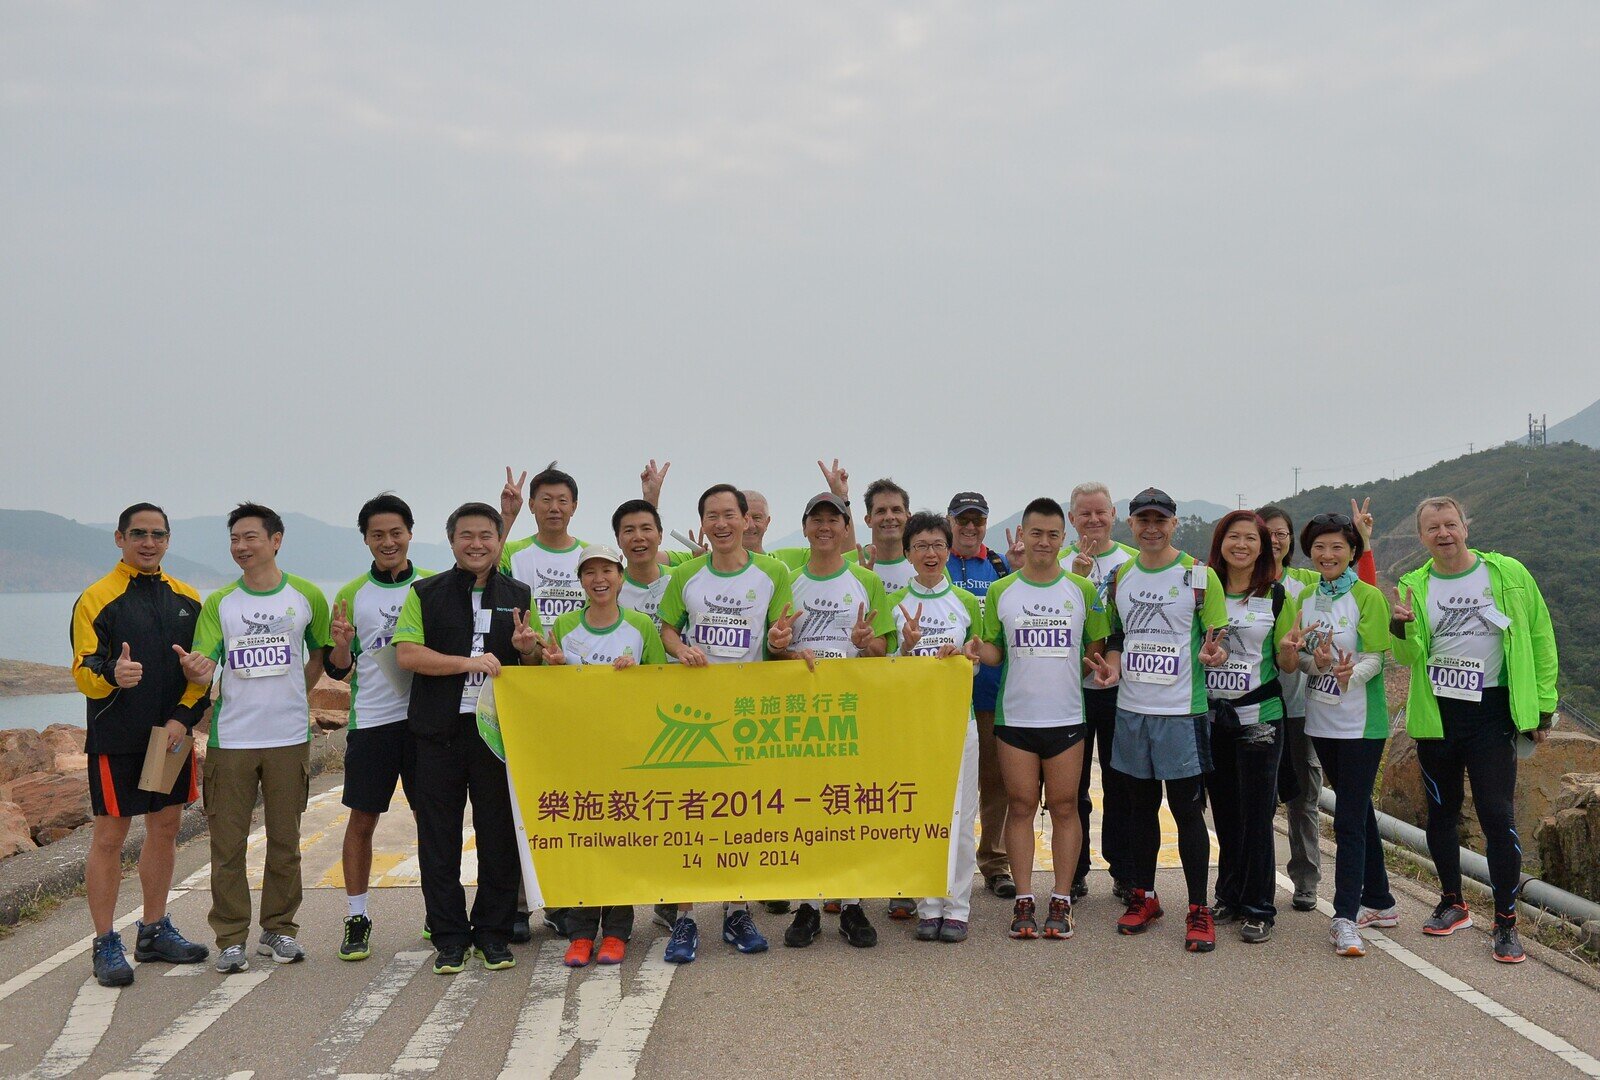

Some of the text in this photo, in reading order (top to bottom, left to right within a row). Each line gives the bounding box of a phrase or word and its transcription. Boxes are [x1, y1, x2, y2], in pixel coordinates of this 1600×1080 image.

[565, 590, 582, 598] 2014
[728, 618, 748, 626] 2014
[265, 636, 286, 644] 2014
[698, 625, 745, 648] L0001
[1019, 629, 1068, 648] L0015
[233, 646, 287, 669] L0005
[1156, 645, 1176, 654] 2014
[1129, 653, 1176, 675] L0020
[1229, 662, 1248, 671] 2014
[1460, 660, 1480, 669] 2014
[1206, 671, 1247, 690] 0006
[1429, 667, 1480, 691] L0009
[733, 691, 859, 718] 樂施毅行者
[732, 714, 859, 744] OXFAM
[733, 741, 860, 761] TRAILWALKER
[819, 781, 918, 816] 領袖行
[567, 831, 659, 848] Trailwalker
[663, 831, 704, 847] 2014
[724, 828, 789, 847] Leaders
[793, 825, 856, 847] Against
[860, 823, 921, 844] Poverty
[683, 850, 800, 869] 14 NOV 2014
